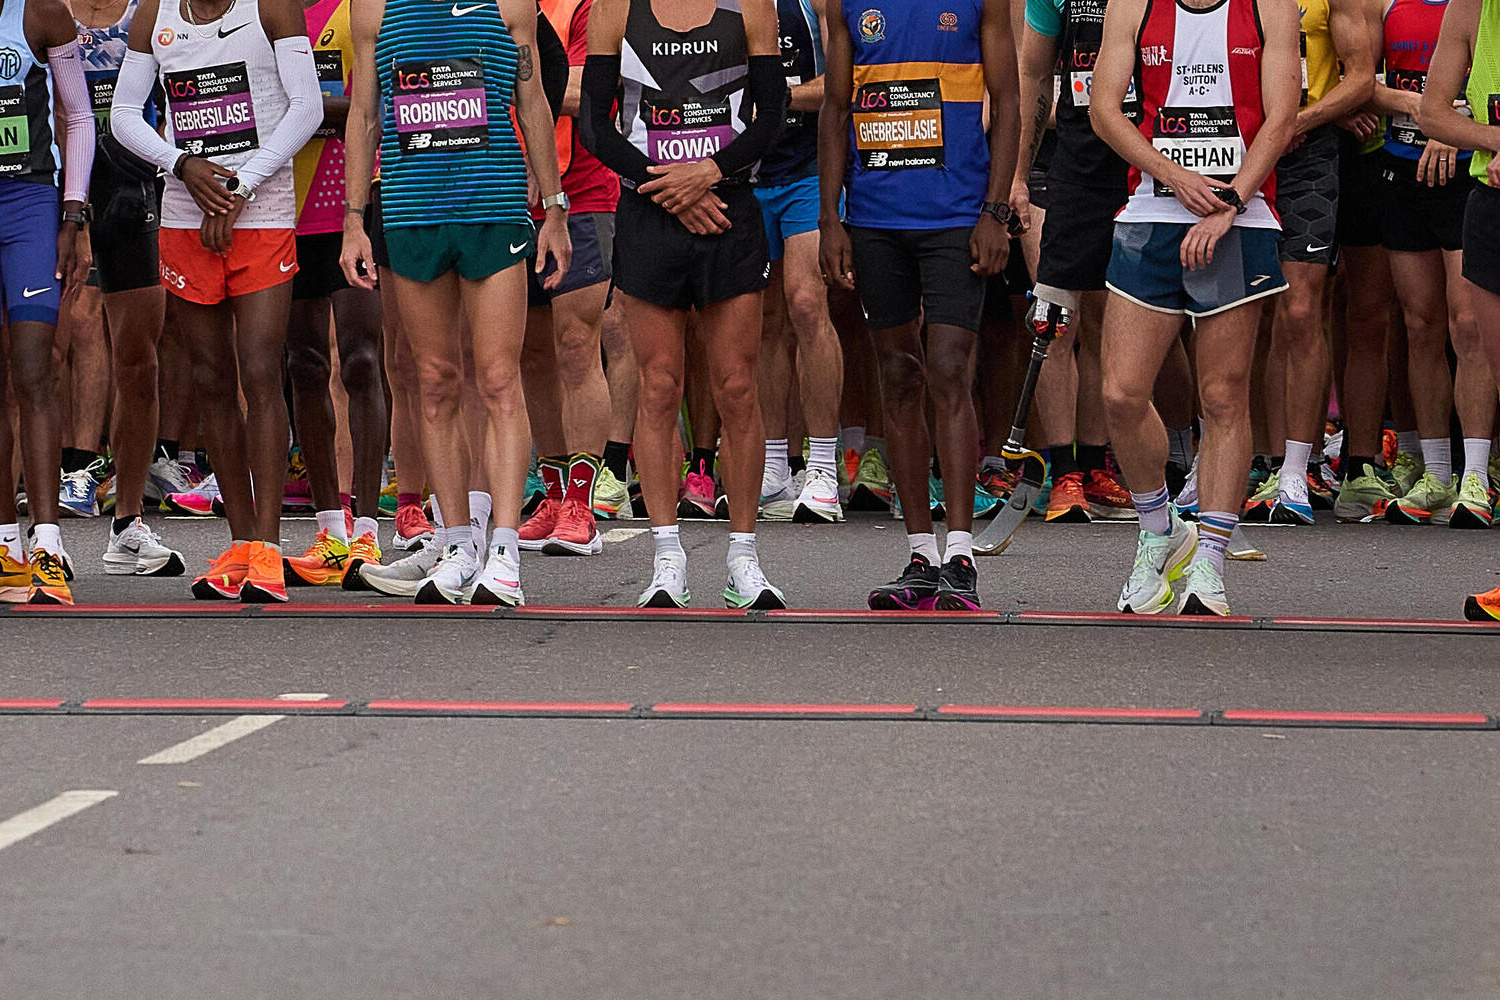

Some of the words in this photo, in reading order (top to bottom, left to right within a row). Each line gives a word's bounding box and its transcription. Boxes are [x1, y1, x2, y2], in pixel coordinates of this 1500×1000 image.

[652, 40, 719, 56] KIPRUN
[1192, 64, 1224, 75] HELENS
[196, 72, 217, 81] TATA
[398, 70, 430, 90] tcs
[432, 70, 478, 81] CONSULTANCY
[1183, 75, 1217, 85] SUTTON
[197, 75, 242, 88] CONSULTANCY
[432, 79, 462, 88] SERVICES
[168, 79, 196, 97] tcs
[199, 84, 228, 95] SERVICES
[861, 90, 887, 109] tcs
[889, 91, 935, 100] CONSULTANCY
[890, 99, 919, 107] SERVICES
[174, 102, 251, 131] GEBRESILASE
[399, 98, 482, 125] ROBINSON
[652, 105, 681, 126] tcs
[683, 107, 727, 117] CONSULTANCY
[683, 116, 713, 124] SERVICES
[1159, 112, 1187, 134] tcs
[1189, 118, 1234, 127] CONSULTANCY
[859, 119, 938, 143] GHEBRESILASIE
[1190, 126, 1219, 134] SERVICES
[219, 140, 251, 151] balance
[448, 137, 481, 146] balance
[904, 157, 936, 166] balance
[159, 260, 186, 289] EOS
